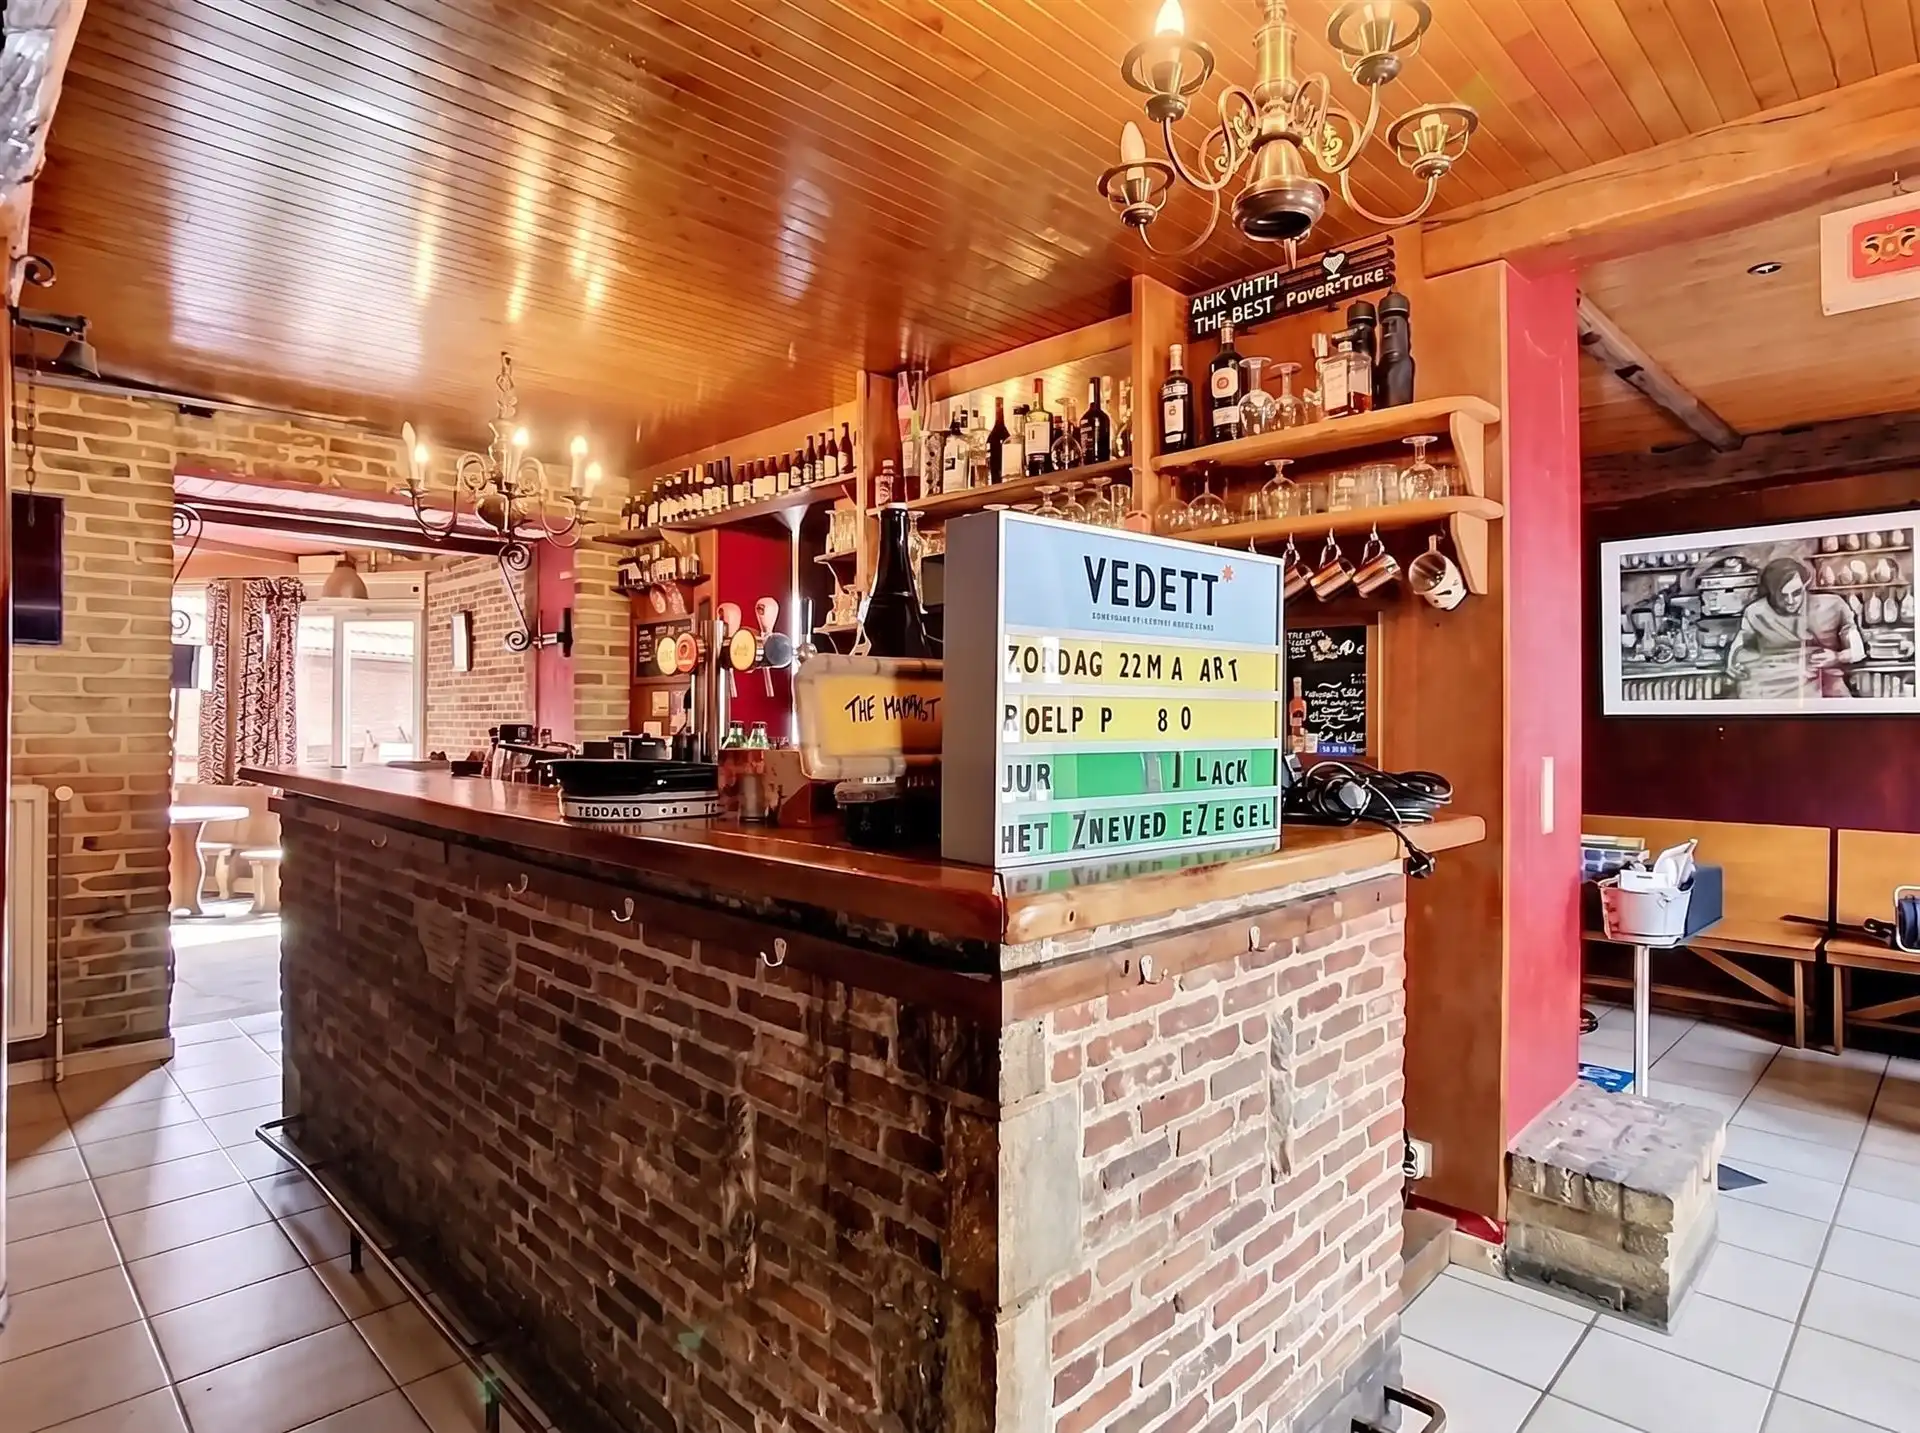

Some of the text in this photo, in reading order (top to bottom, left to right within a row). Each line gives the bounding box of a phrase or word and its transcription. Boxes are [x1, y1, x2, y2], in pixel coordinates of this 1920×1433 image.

[1194, 294, 1275, 334] THE BEST
[1083, 554, 1219, 617] VEDETT
[845, 694, 876, 723] THE
[1001, 822, 1049, 854] HET
